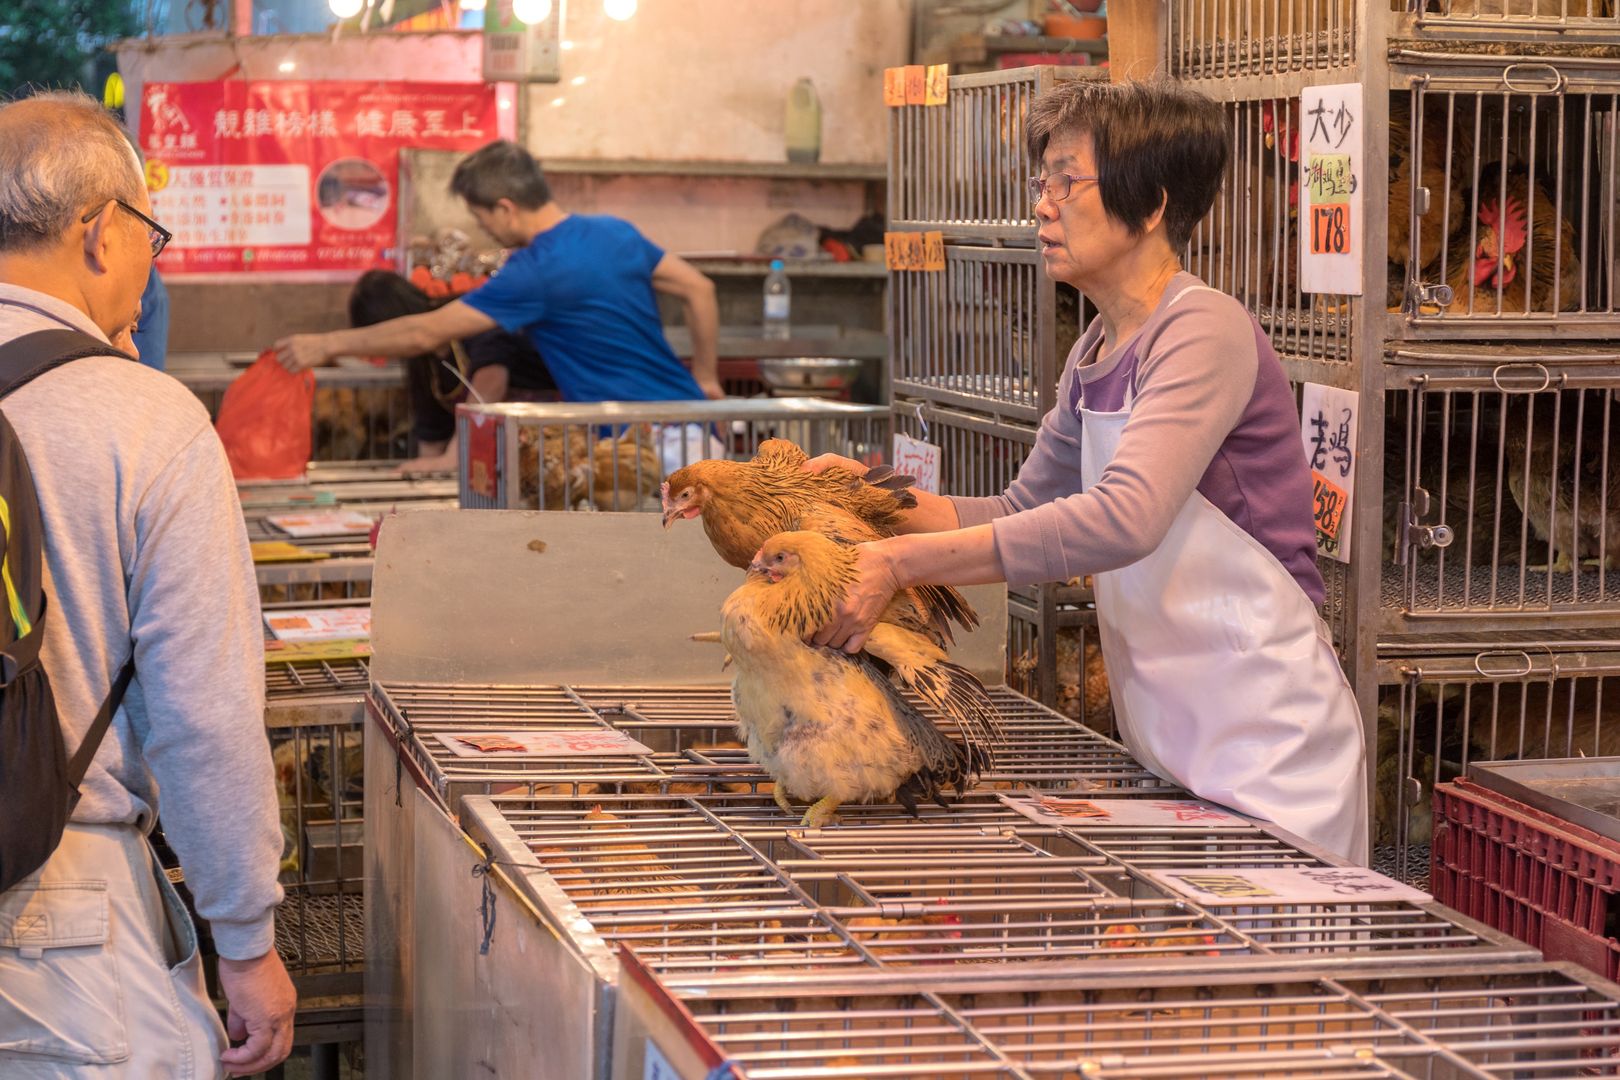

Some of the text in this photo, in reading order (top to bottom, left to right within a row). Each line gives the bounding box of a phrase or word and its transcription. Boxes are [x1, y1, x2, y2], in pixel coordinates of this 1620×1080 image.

[355, 109, 484, 139] 健康至上
[1314, 207, 1344, 253] 178
